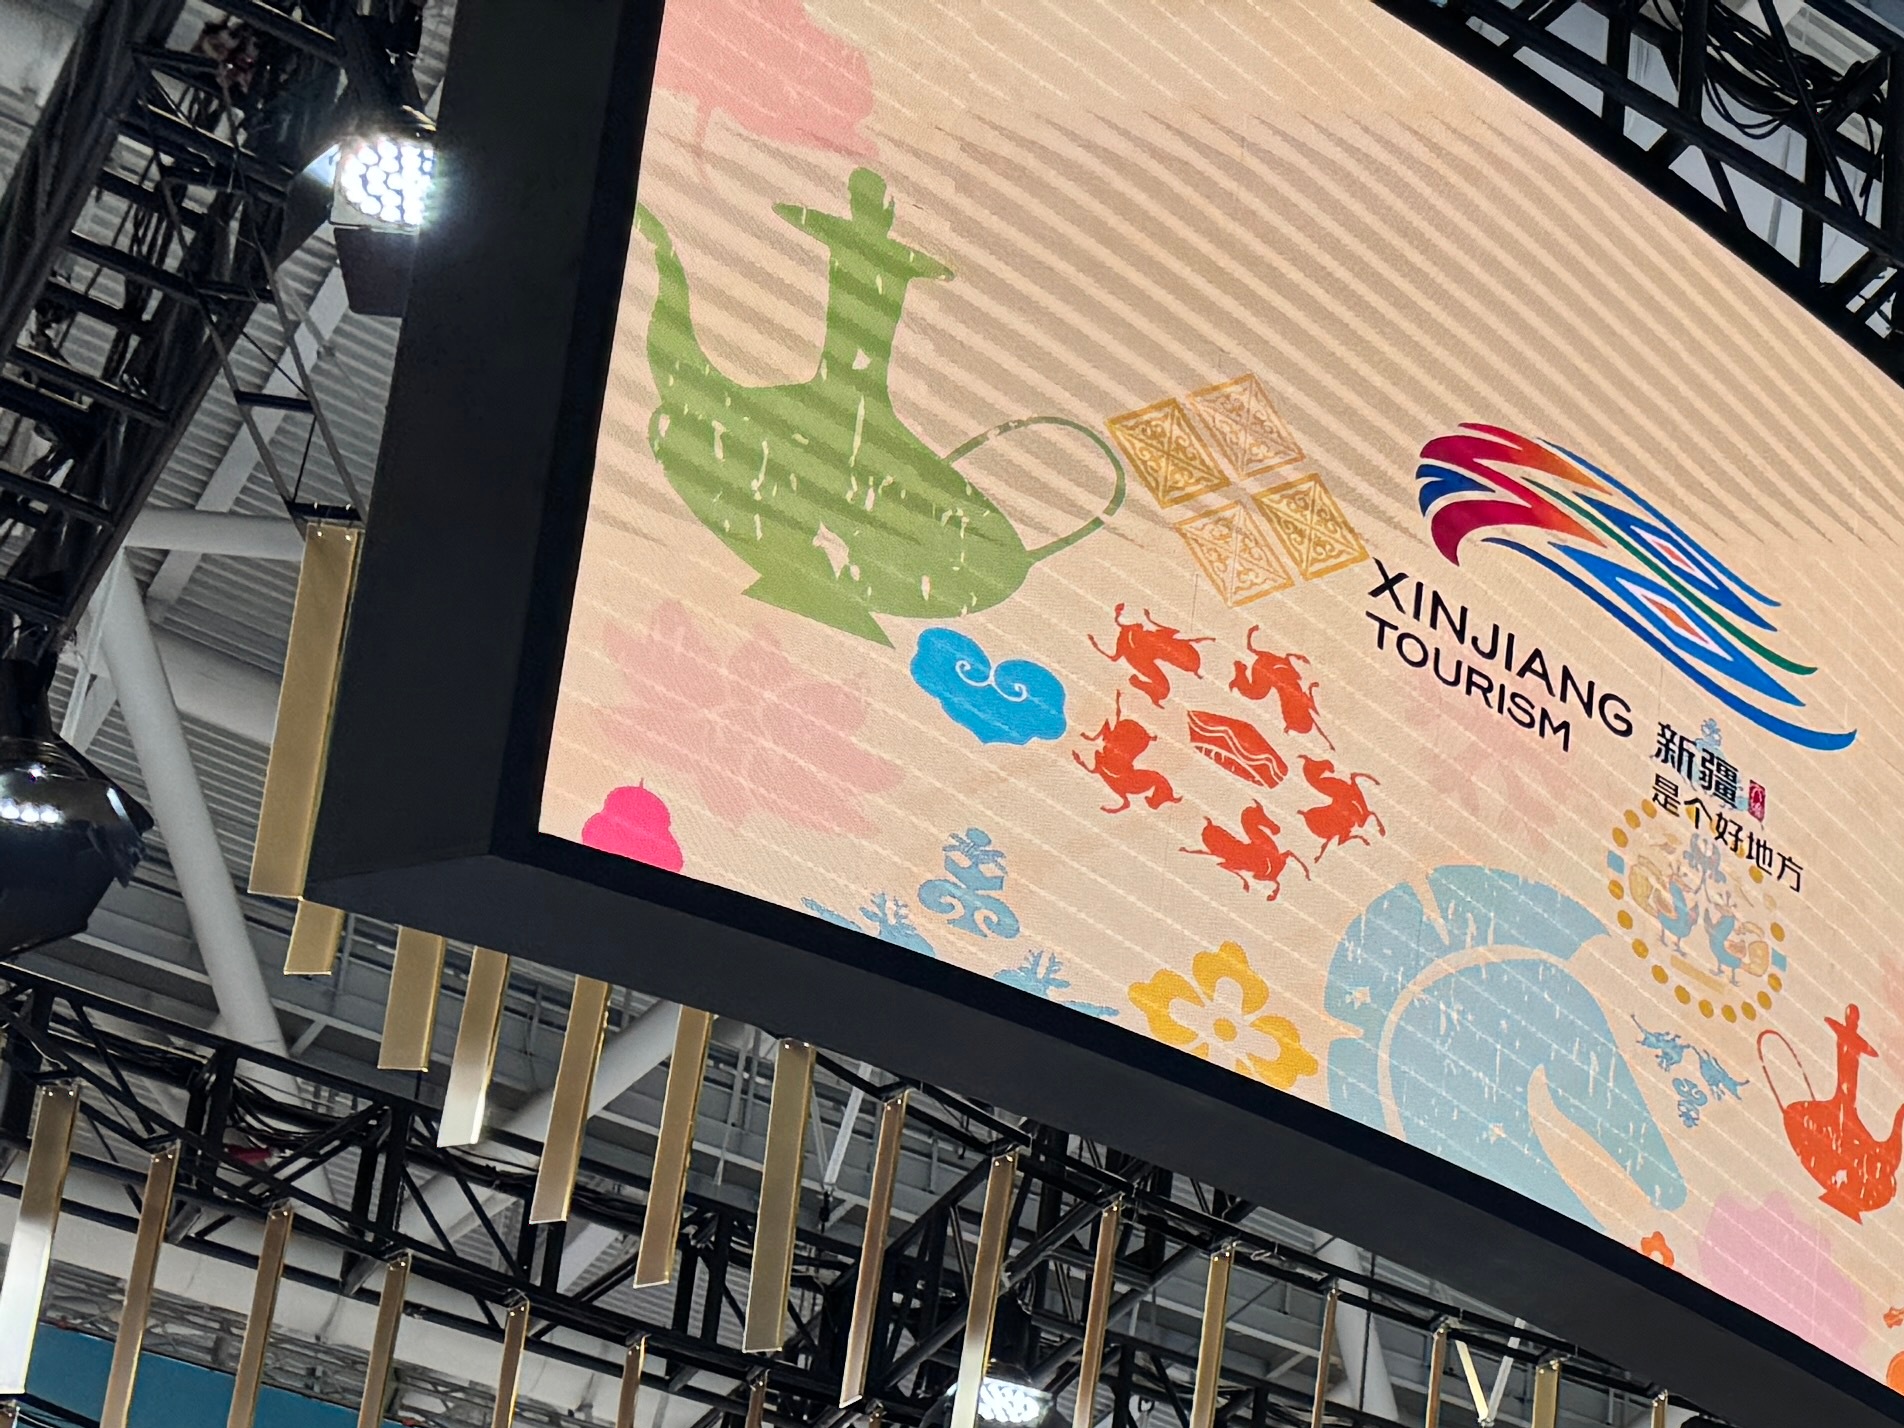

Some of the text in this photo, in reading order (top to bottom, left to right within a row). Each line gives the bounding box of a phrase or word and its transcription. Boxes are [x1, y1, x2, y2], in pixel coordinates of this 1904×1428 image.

[1365, 610, 1571, 753] TOURISM
[1368, 557, 1633, 738] XINJIANG
[1653, 721, 1739, 810] 新疆
[1652, 773, 1804, 894] 是个好地方
